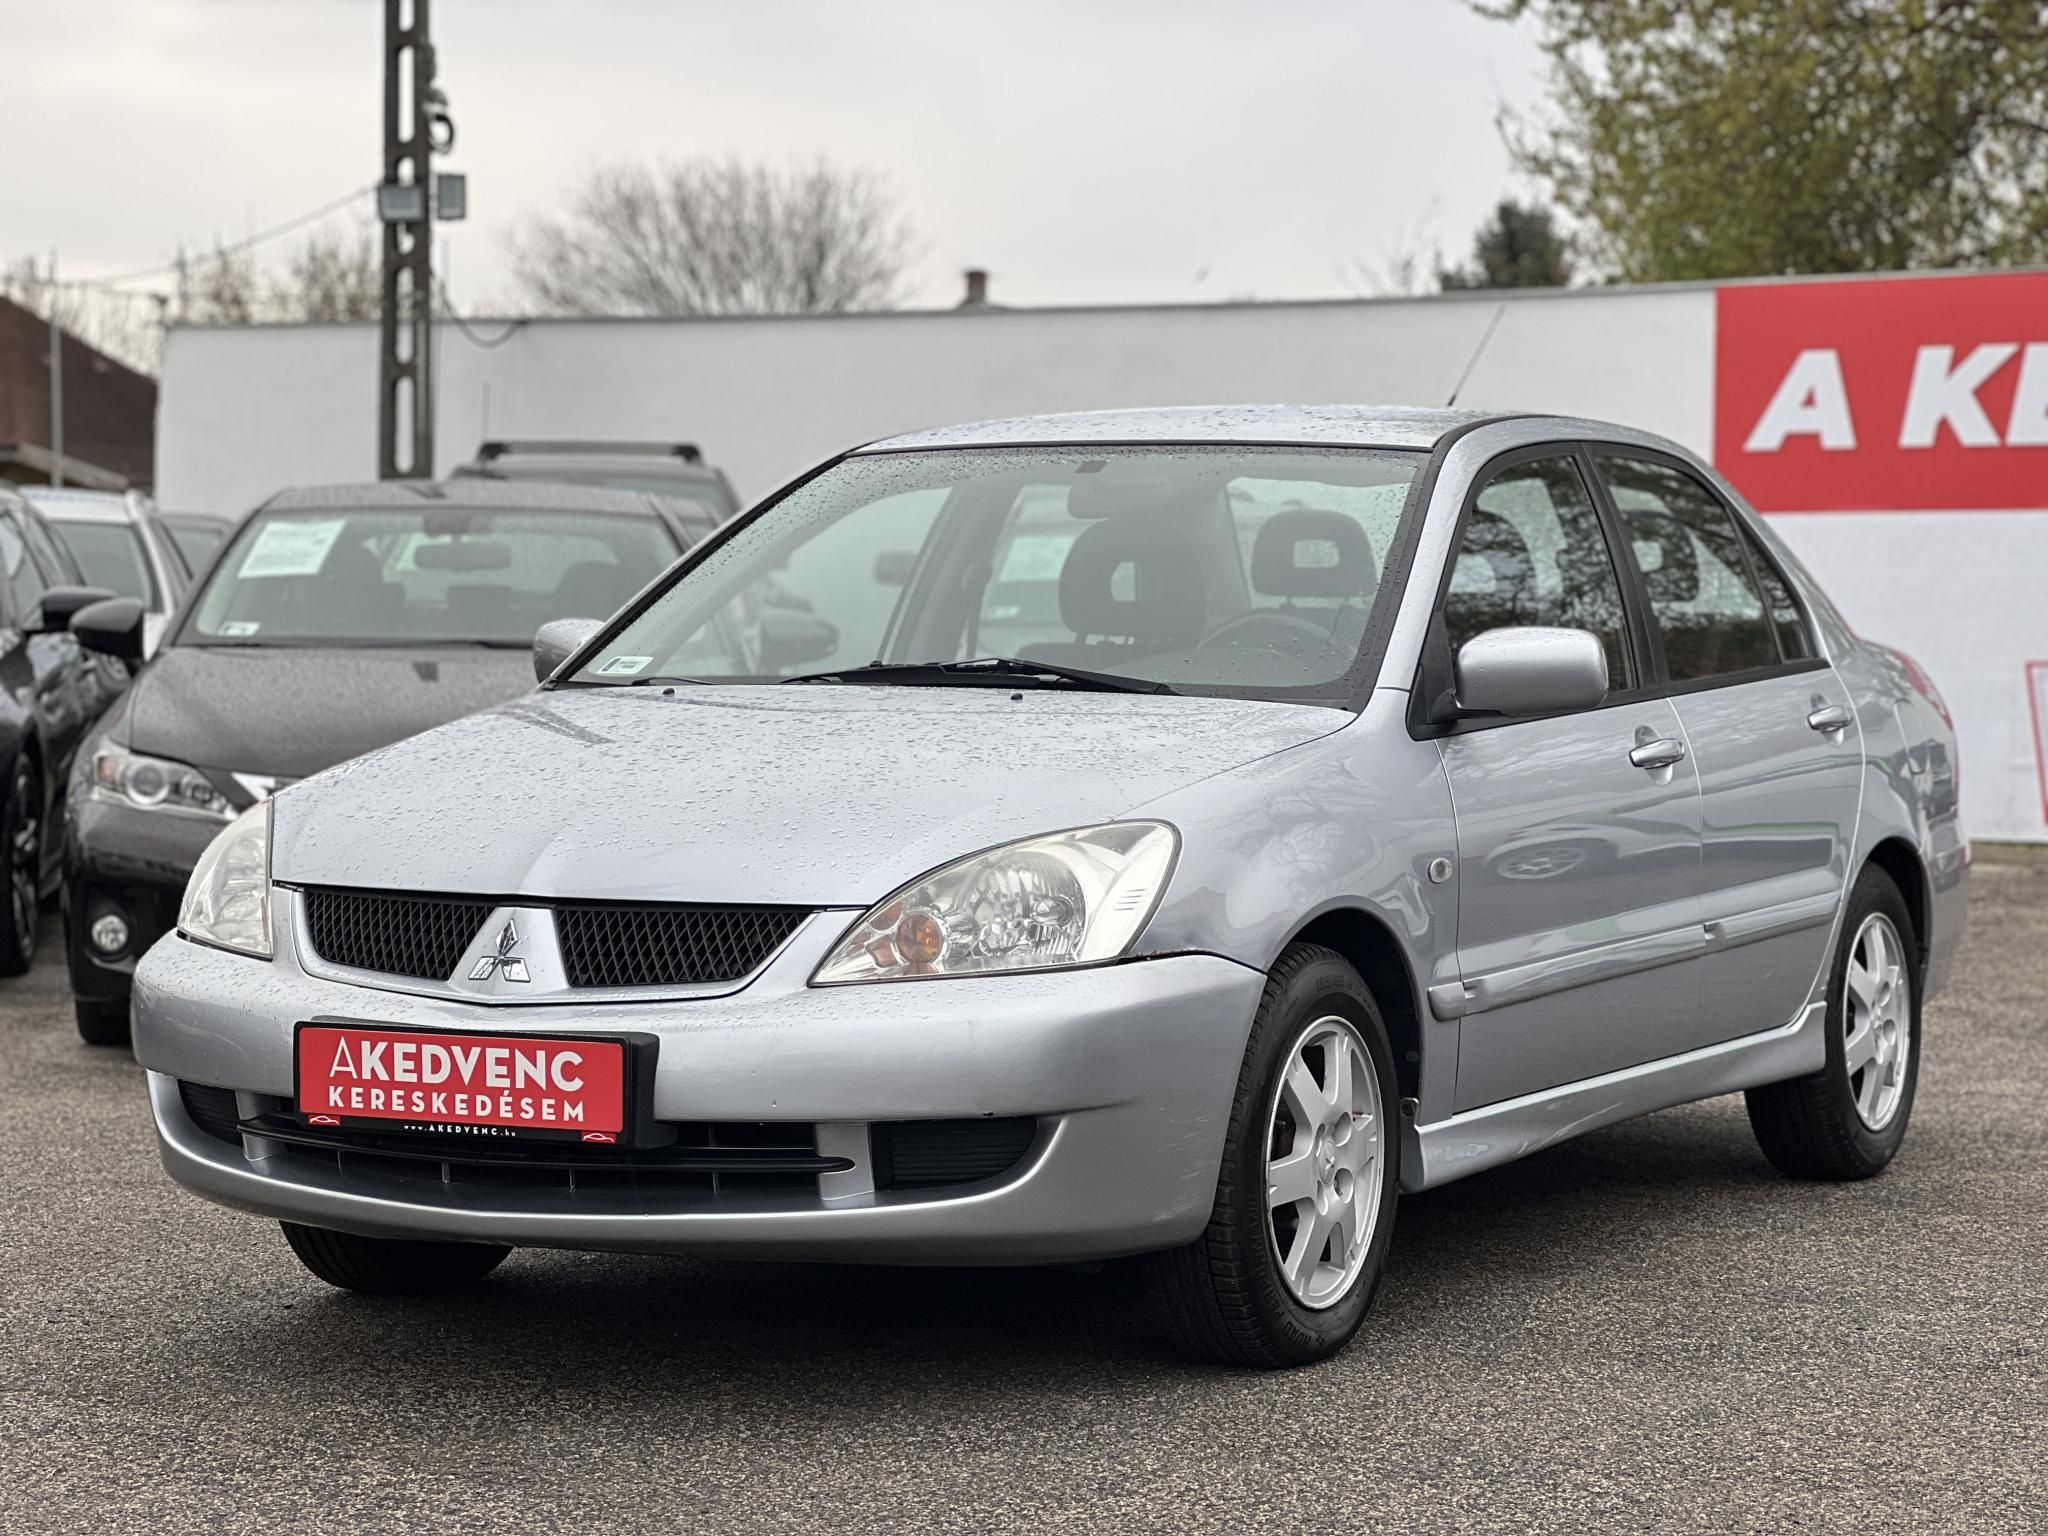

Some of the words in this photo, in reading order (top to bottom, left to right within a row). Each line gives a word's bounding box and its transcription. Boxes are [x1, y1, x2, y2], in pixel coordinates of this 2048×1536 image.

[1744, 348, 1857, 452] A
[329, 1085, 584, 1122] KERESKEDÉSEM
[404, 1124, 516, 1136] www.AKEDVENC.hu
